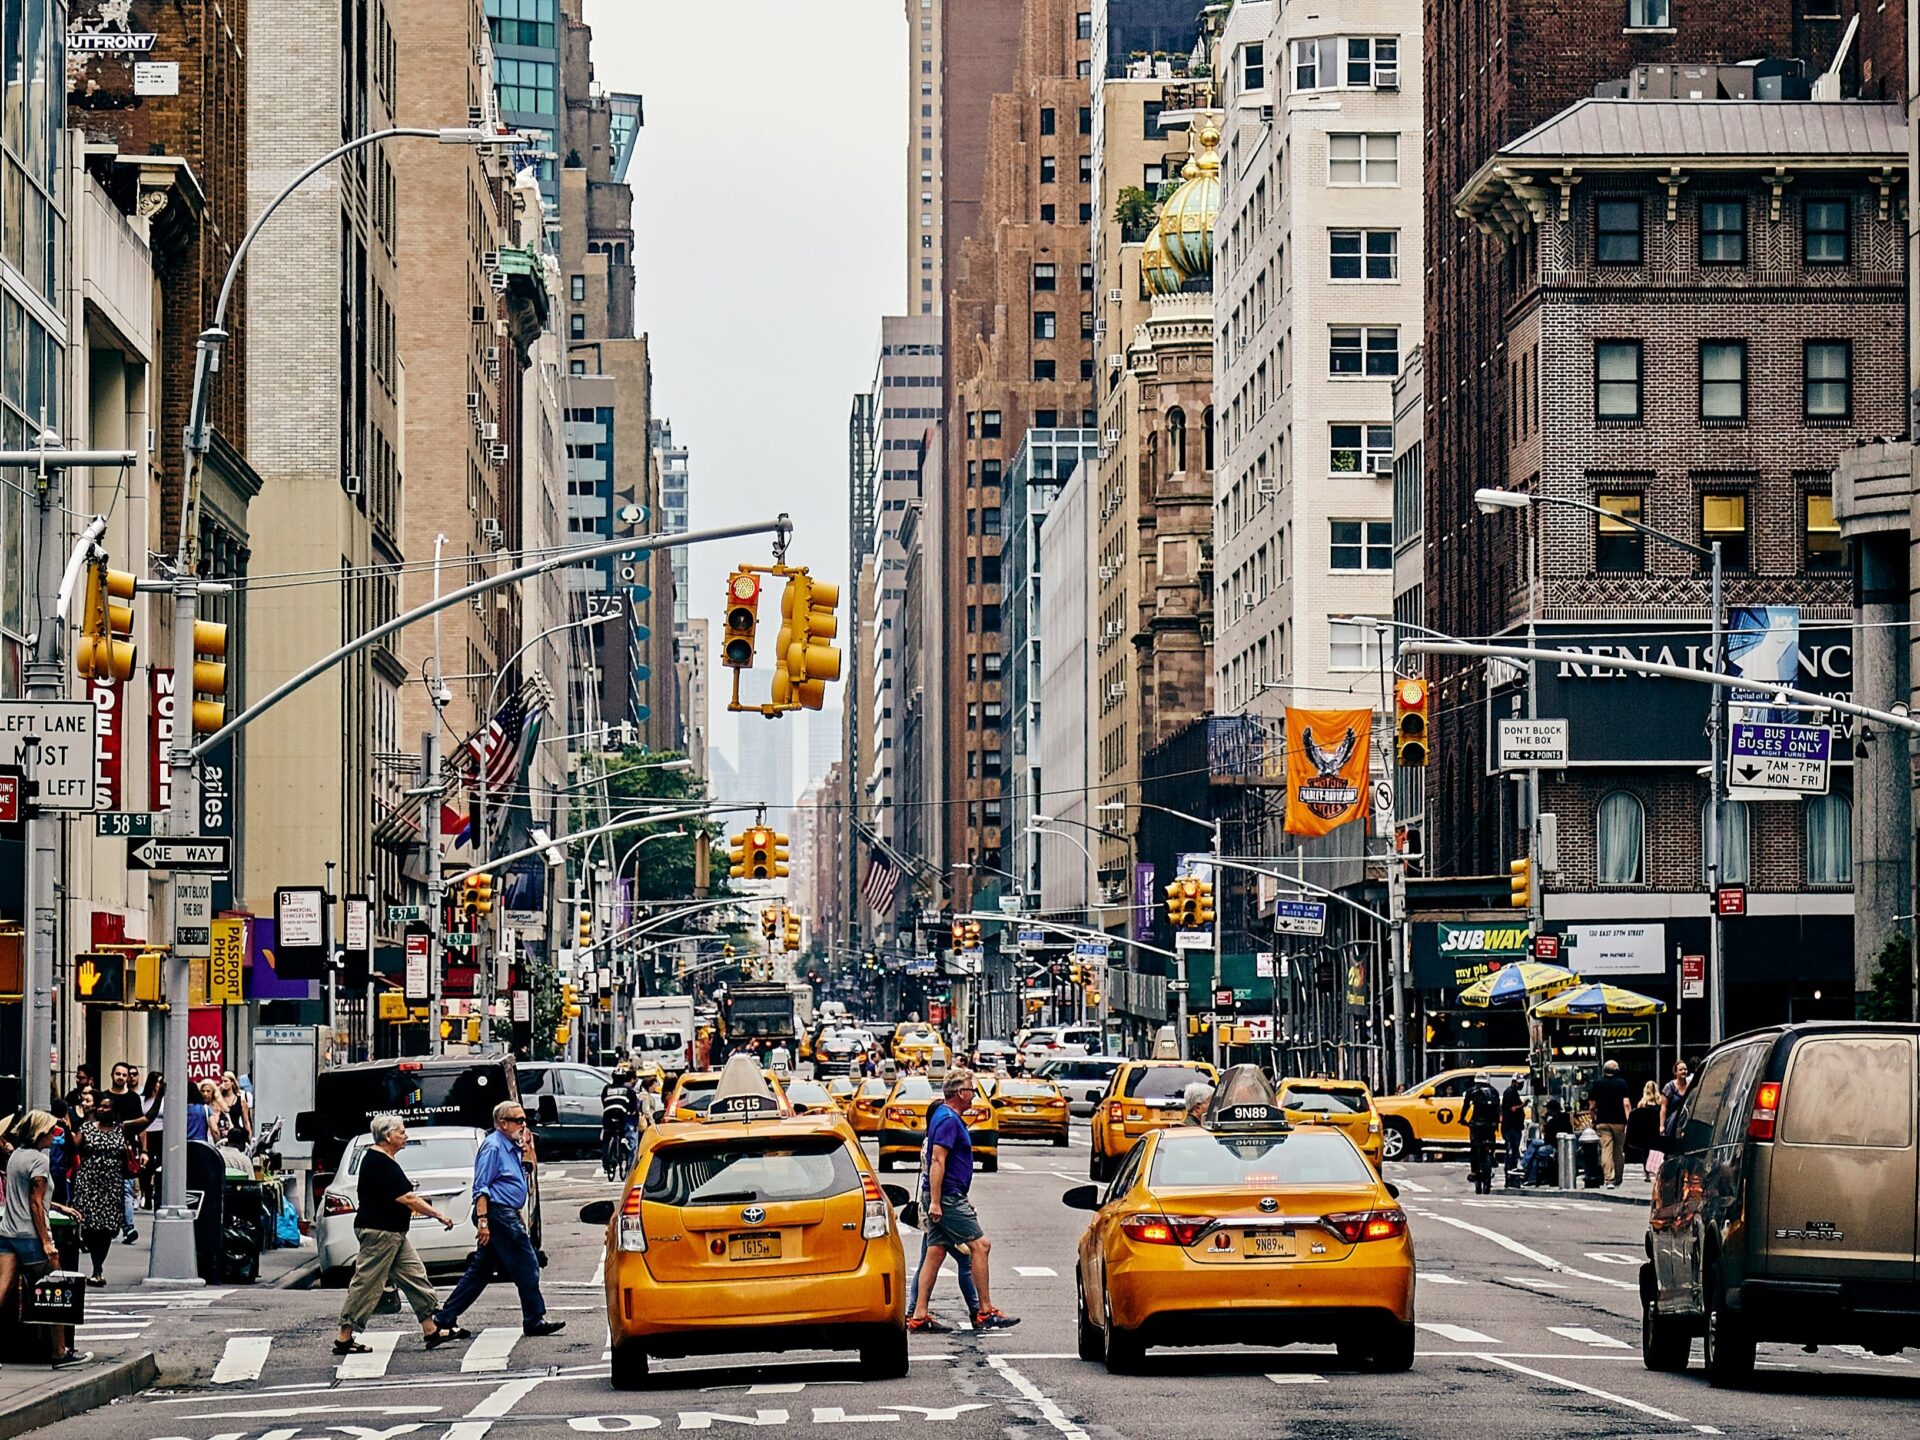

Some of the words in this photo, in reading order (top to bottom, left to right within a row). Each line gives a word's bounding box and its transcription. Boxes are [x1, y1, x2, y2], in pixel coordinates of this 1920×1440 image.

[45, 716, 86, 732] LANE
[1505, 727, 1530, 735] DON'T
[1533, 727, 1562, 735] BLOCK
[1764, 729, 1786, 740] BUS
[1791, 730, 1820, 742] LANE
[1738, 739, 1782, 751] BUSES
[1789, 742, 1822, 754] ONLY
[1505, 751, 1521, 759] FINE
[1523, 751, 1535, 759] +2
[1537, 751, 1561, 759] POINTS
[1766, 761, 1788, 771] 7AM
[1767, 774, 1789, 784] MON
[1801, 776, 1818, 786] FRI
[48, 780, 85, 796] LEFT
[100, 815, 107, 834] E
[113, 815, 130, 834] 58
[136, 815, 148, 825] ST
[143, 847, 172, 861] ONE
[186, 848, 217, 861] WAY
[193, 885, 209, 899] BLOCK
[283, 894, 290, 905] 3
[183, 903, 193, 916] THE
[193, 903, 203, 916] BOX
[390, 908, 396, 920] E
[399, 907, 408, 920] 57
[1440, 930, 1530, 951] SUBWAY
[214, 938, 226, 985] PHOTO
[227, 927, 240, 996] PASSPORT
[1455, 968, 1471, 978] my
[1473, 963, 1488, 976] pie
[266, 1030, 303, 1038] Phone
[187, 1035, 219, 1049] 00%
[413, 1106, 461, 1114] ELEVATOR
[1234, 1107, 1268, 1119] 9N89
[1440, 1110, 1450, 1123] T
[567, 1403, 993, 1432] ONLY
